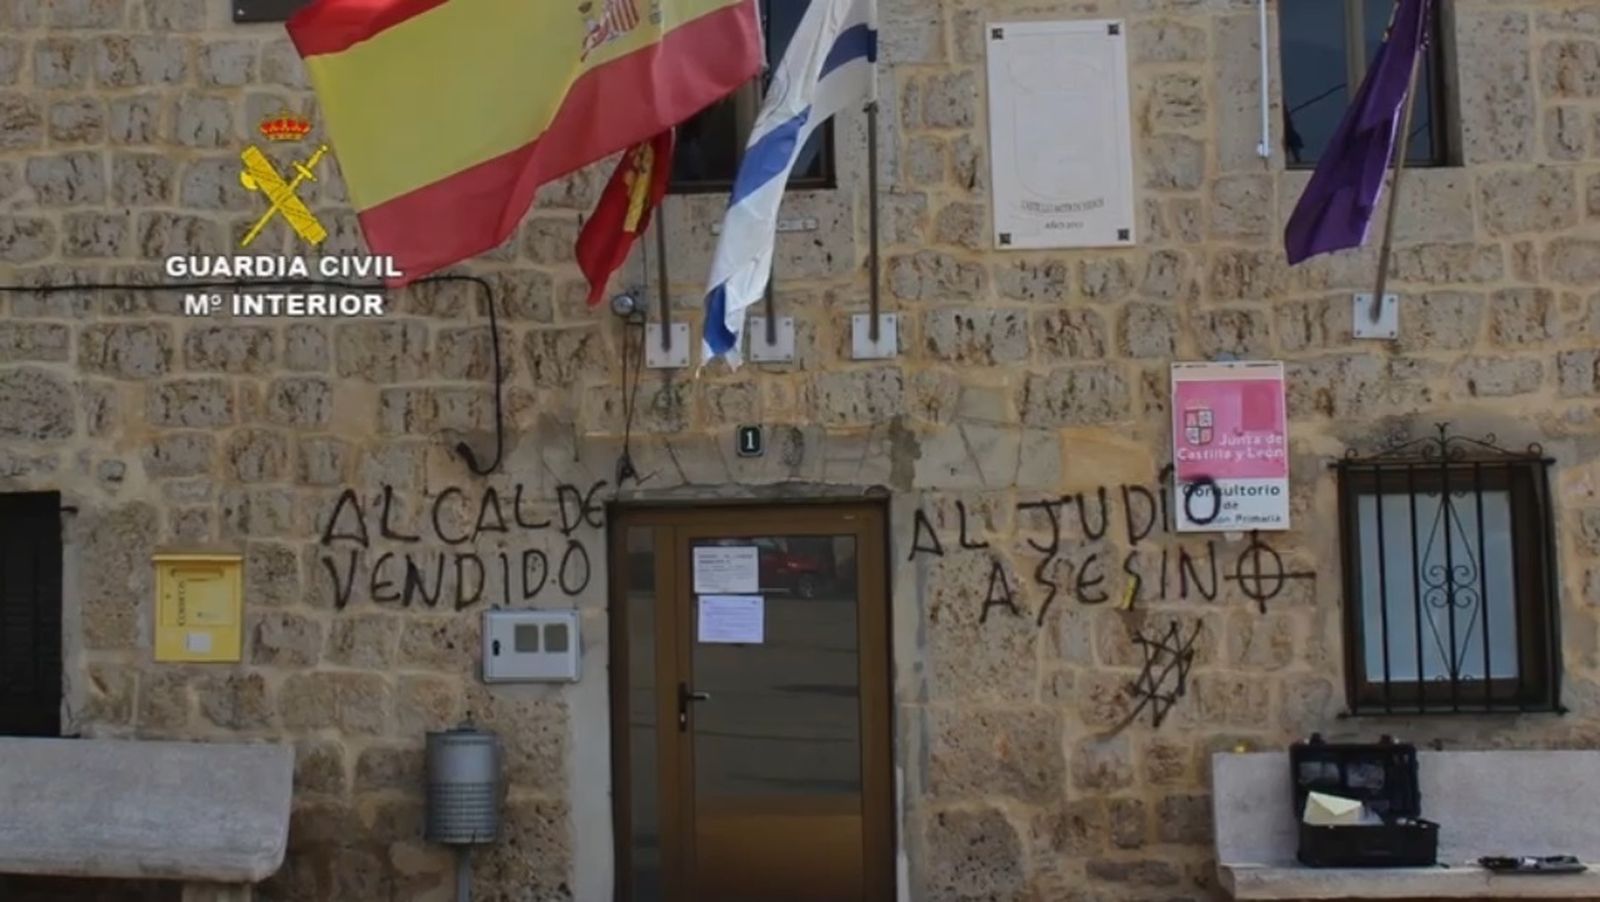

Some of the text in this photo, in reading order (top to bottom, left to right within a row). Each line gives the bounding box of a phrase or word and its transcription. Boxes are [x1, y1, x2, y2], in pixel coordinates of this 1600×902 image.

[745, 432, 755, 450] 1
[1218, 433, 1283, 446] Junta de
[1177, 446, 1284, 463] Castilla y León
[1223, 500, 1239, 510] de
[320, 480, 608, 548] ALCALDE
[1235, 514, 1281, 523] Primaria
[908, 500, 990, 562] AL
[322, 538, 591, 611] VENDIDO
